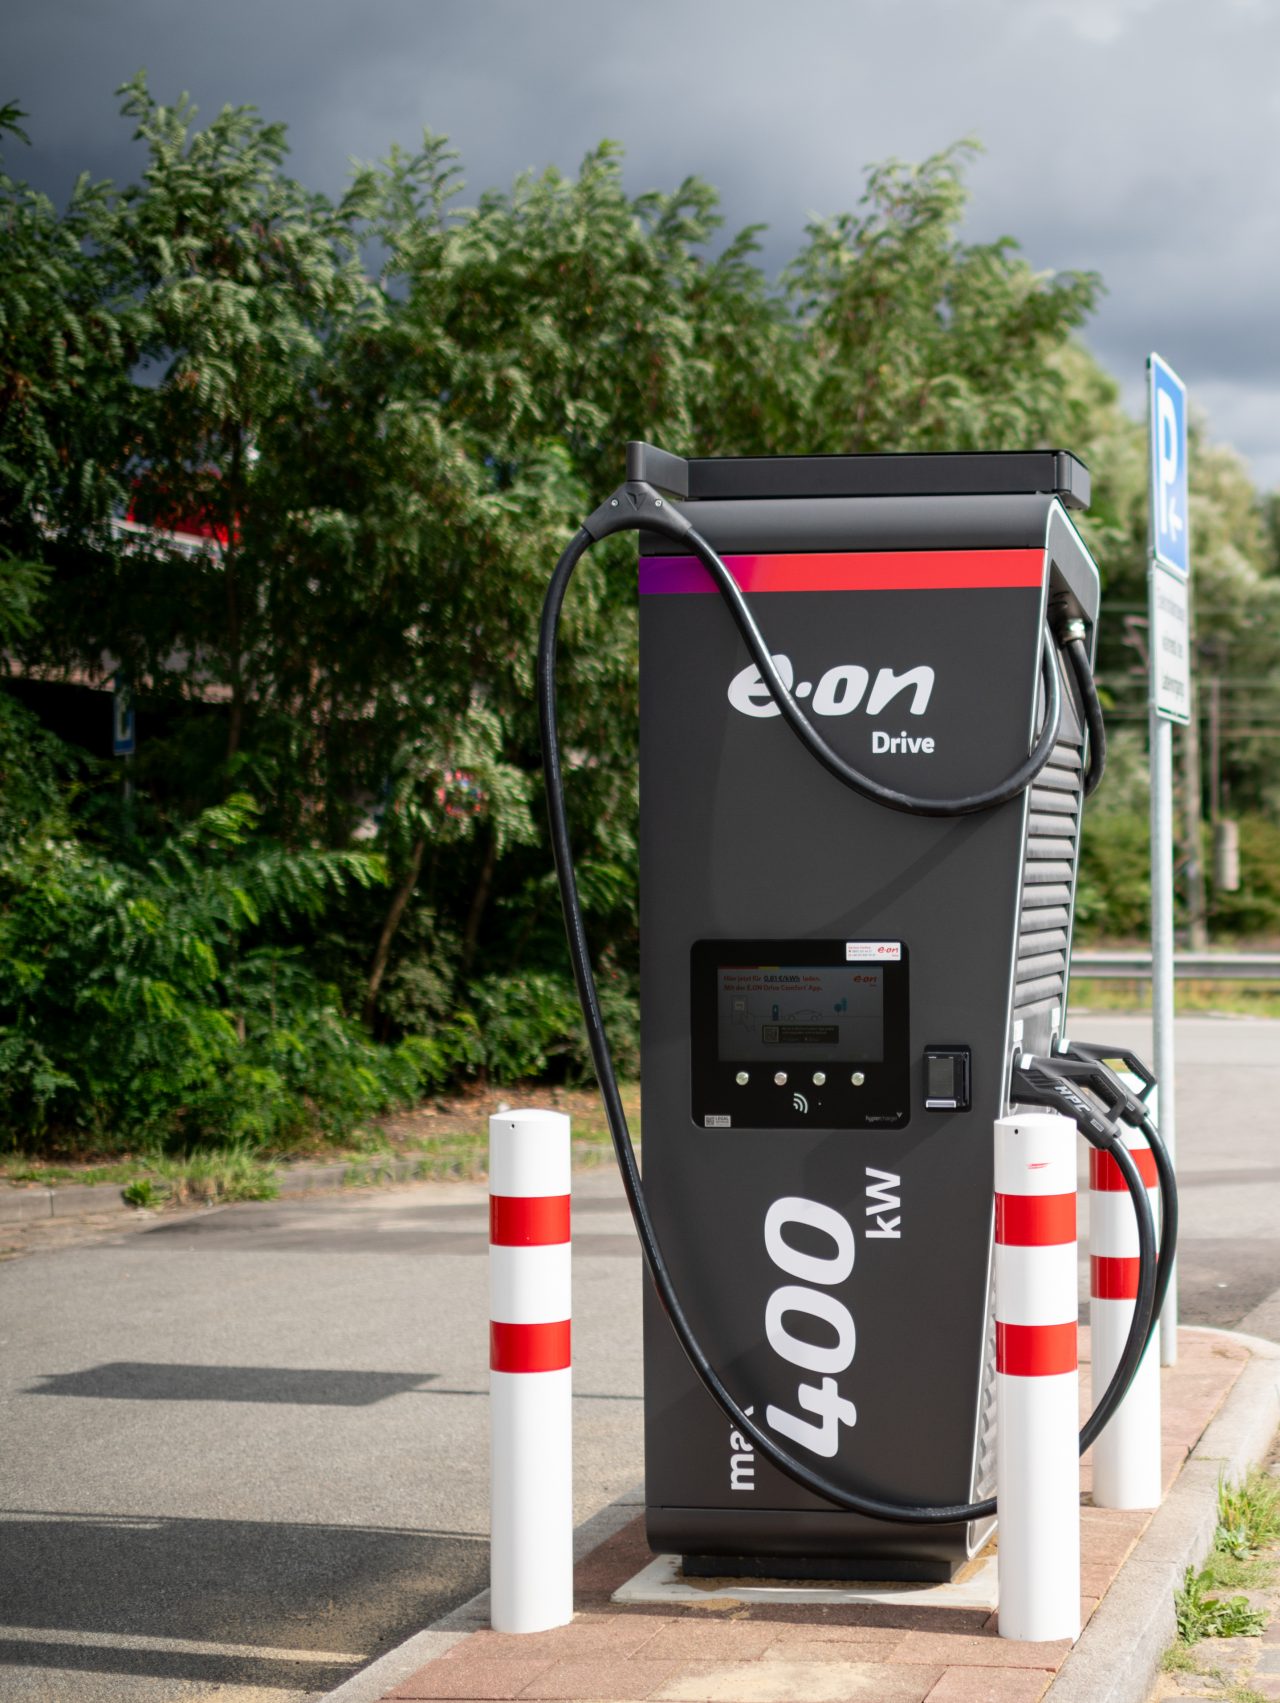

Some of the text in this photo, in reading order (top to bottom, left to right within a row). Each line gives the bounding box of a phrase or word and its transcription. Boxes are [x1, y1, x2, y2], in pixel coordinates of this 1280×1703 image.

[1157, 387, 1178, 535] P
[872, 731, 935, 754] Drive
[1054, 1086, 1091, 1112] HPC
[865, 1166, 901, 1239] kW
[764, 1196, 857, 1458] 400
[730, 1405, 755, 1491] ma
